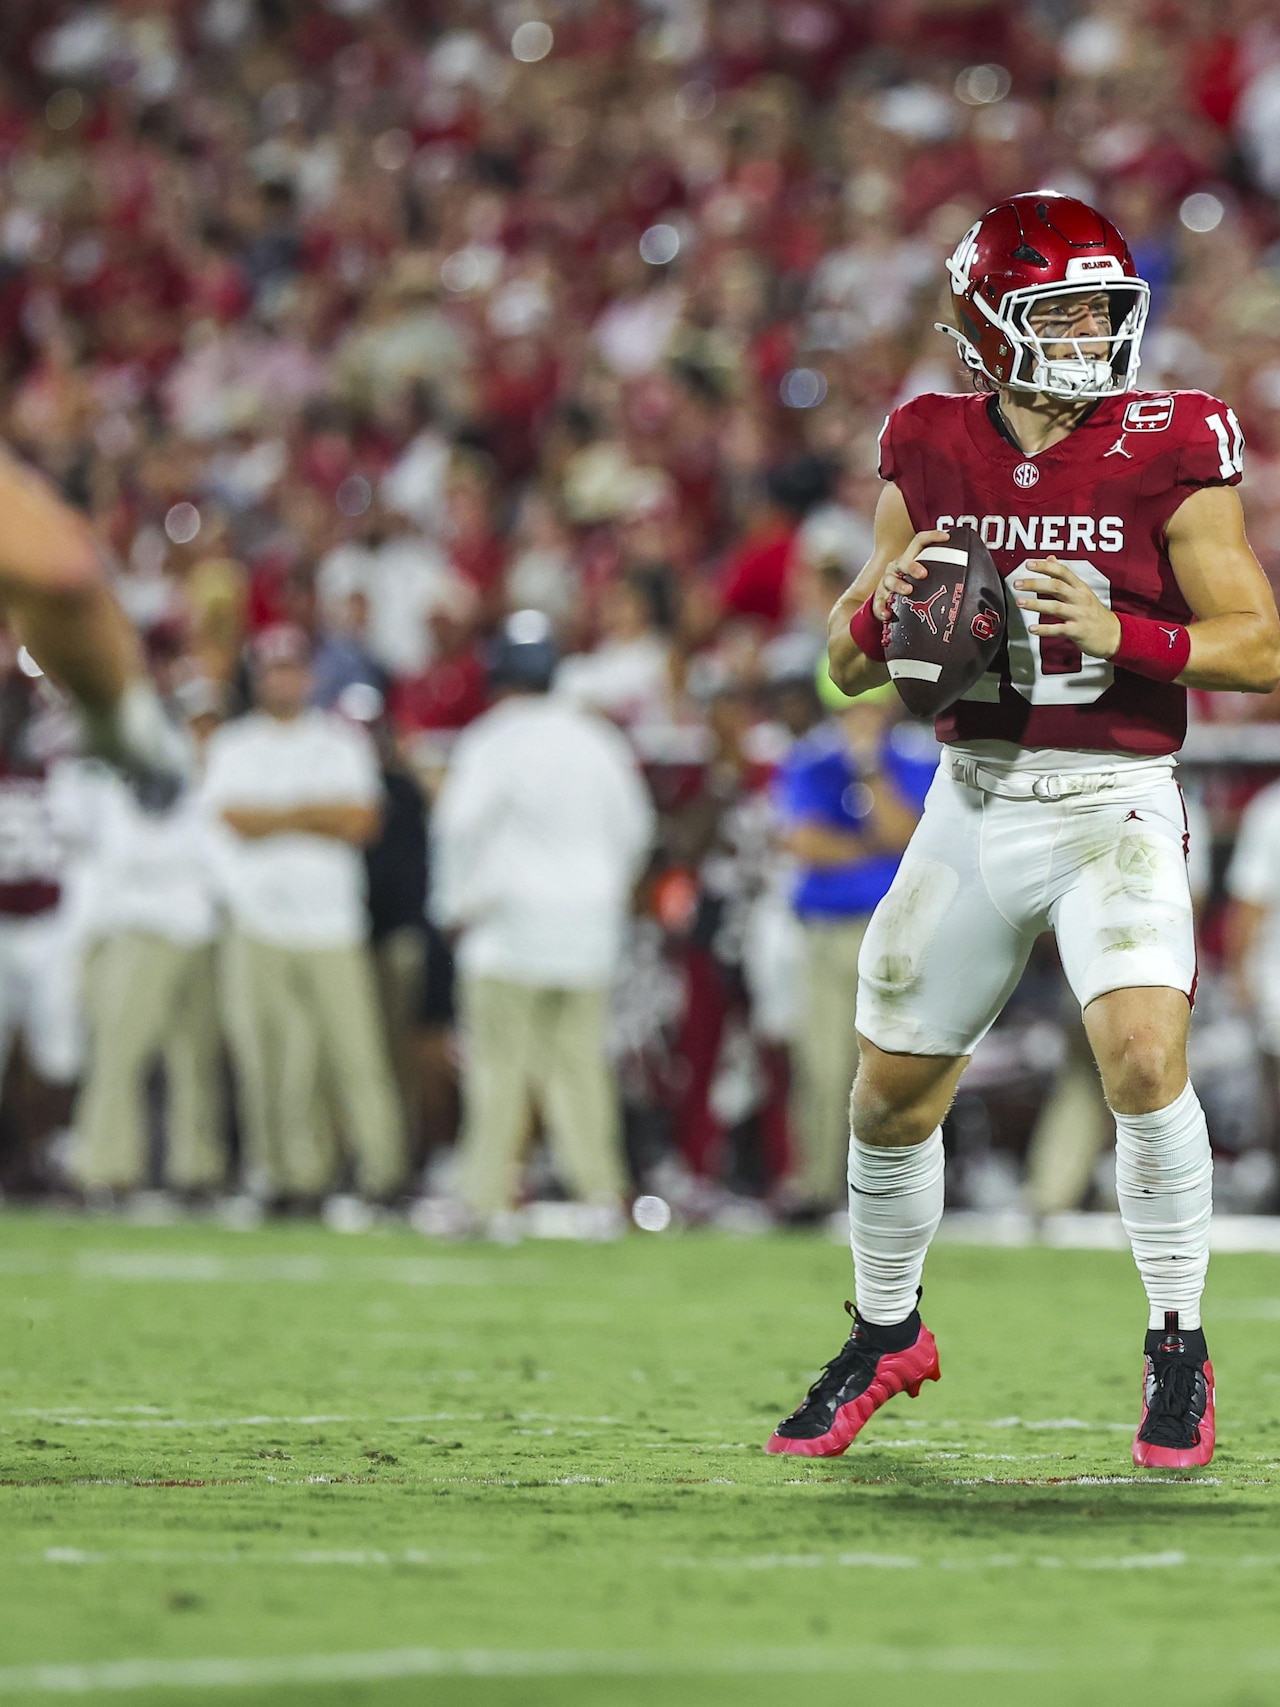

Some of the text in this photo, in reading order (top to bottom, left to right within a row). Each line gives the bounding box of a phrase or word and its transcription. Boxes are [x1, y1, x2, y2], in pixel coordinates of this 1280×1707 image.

[1128, 400, 1171, 422] C
[1015, 464, 1037, 487] SEC
[960, 558, 1115, 706] 0
